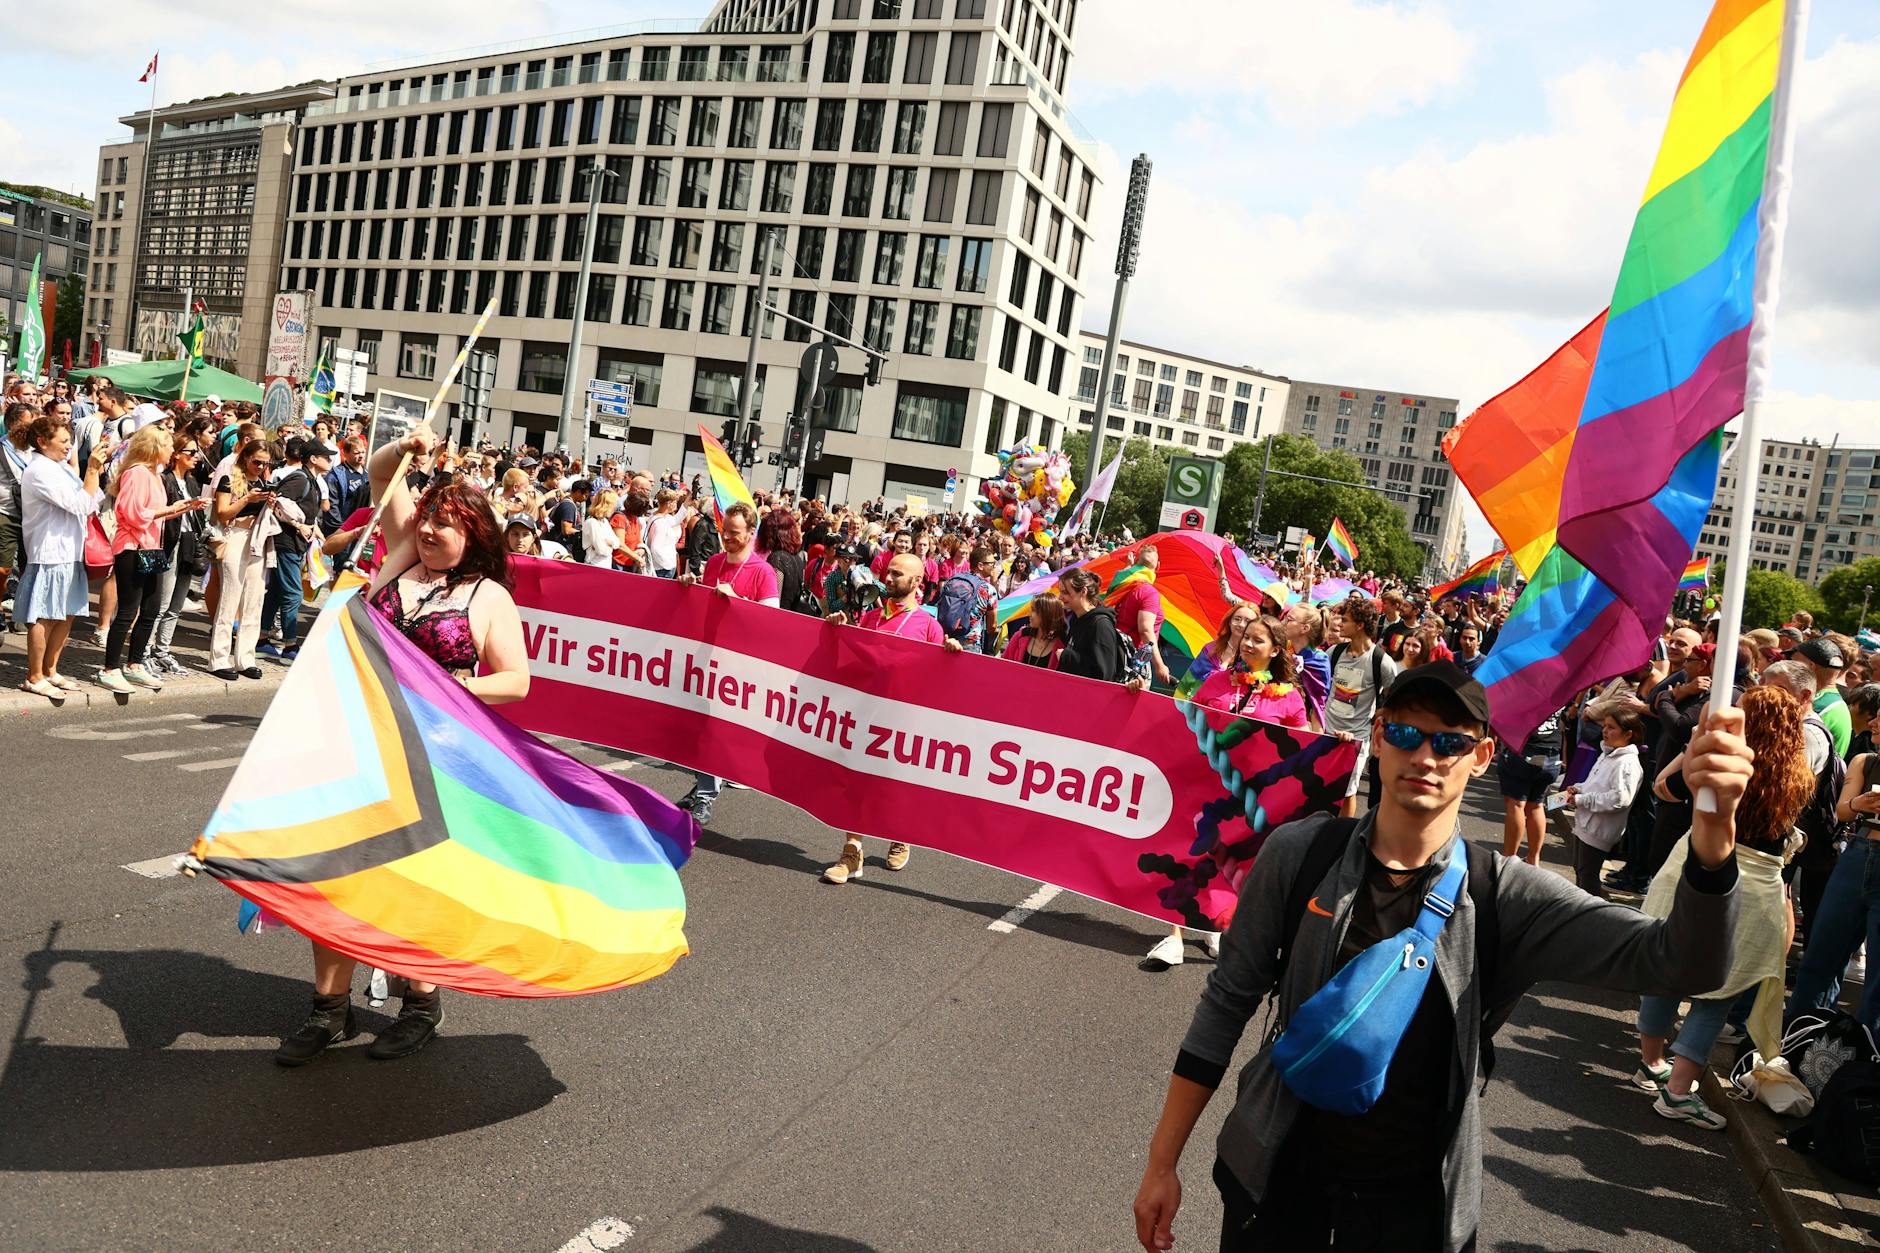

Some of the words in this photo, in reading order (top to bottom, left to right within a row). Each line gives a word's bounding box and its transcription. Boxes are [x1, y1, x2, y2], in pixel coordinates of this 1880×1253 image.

[1177, 466, 1202, 497] S
[1213, 472, 1222, 502] S
[587, 637, 673, 688] sind
[683, 653, 757, 711] hier
[764, 685, 857, 750] nicht
[866, 724, 971, 777] zum
[988, 741, 1146, 820] Spaß!
